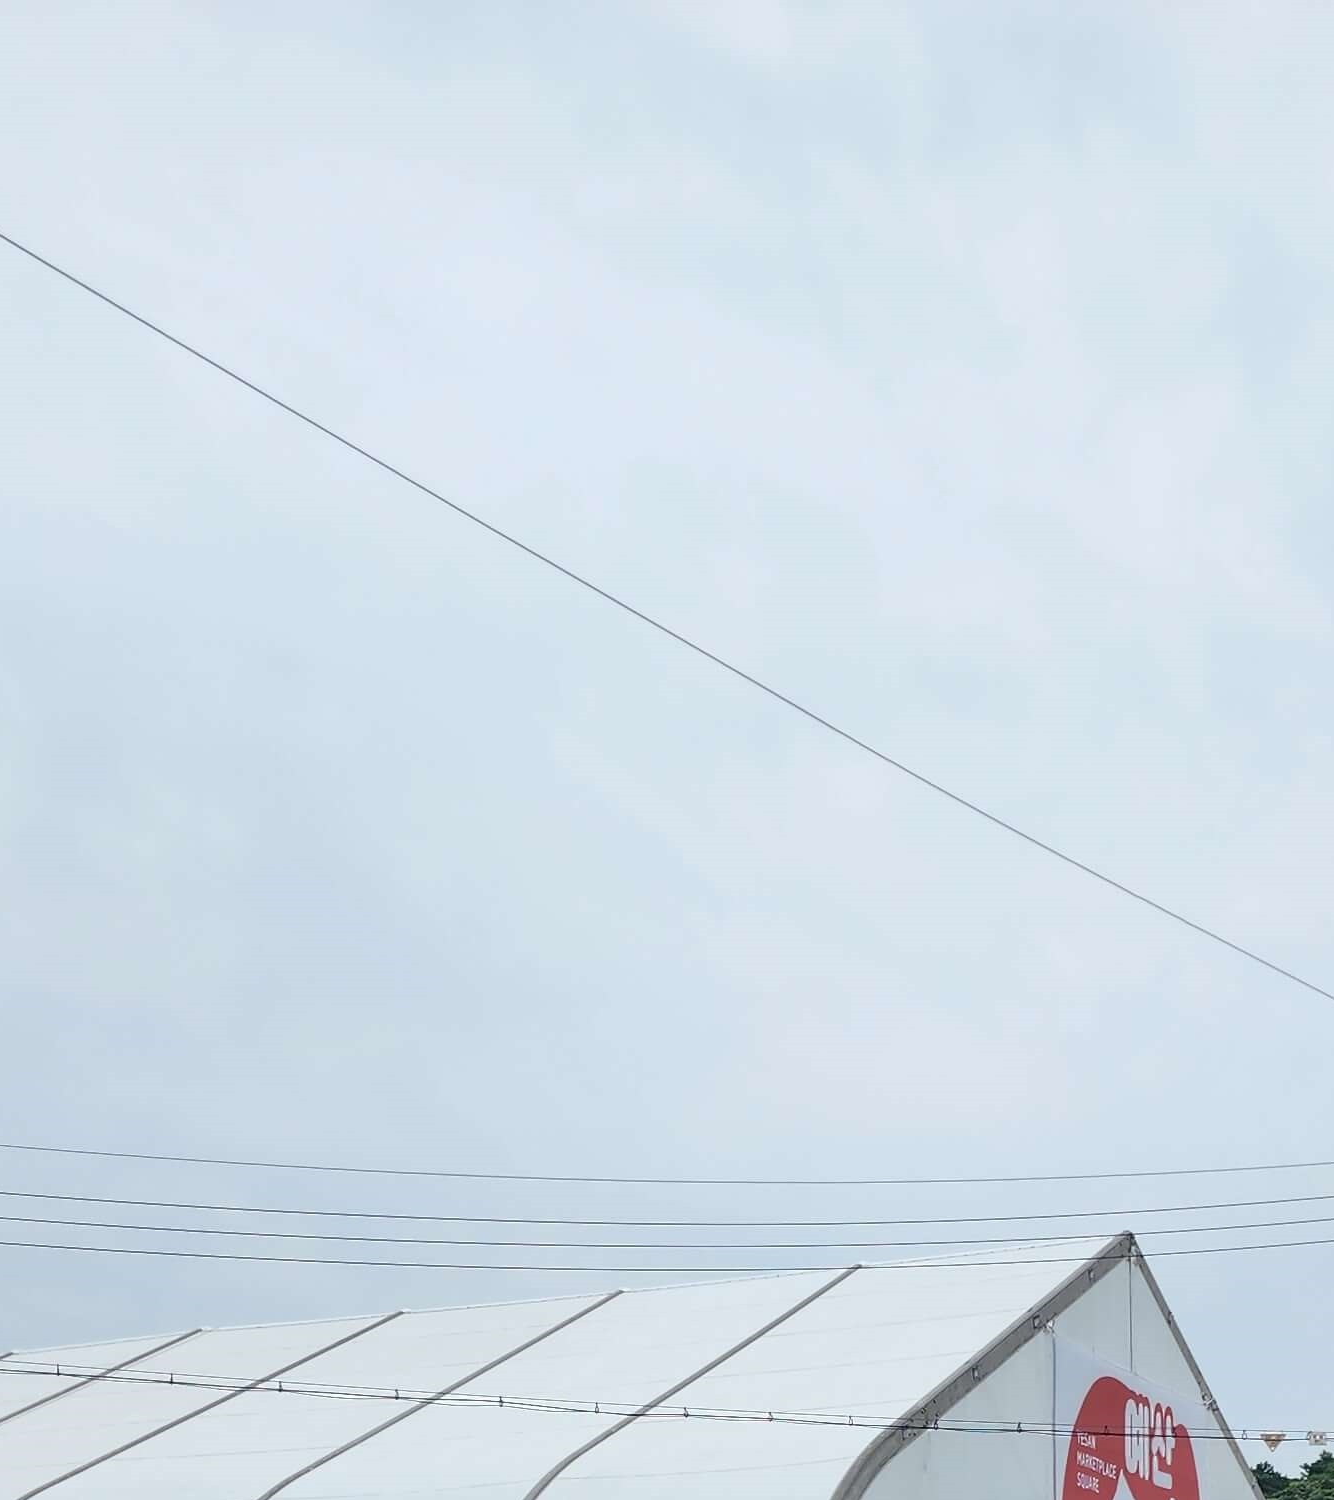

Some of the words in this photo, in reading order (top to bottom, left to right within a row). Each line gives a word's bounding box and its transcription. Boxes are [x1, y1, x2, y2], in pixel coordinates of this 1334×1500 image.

[1124, 1398, 1175, 1489] 예산
[1076, 1450, 1117, 1479] MARKETPLACE
[1076, 1472, 1100, 1493] SQUARE
